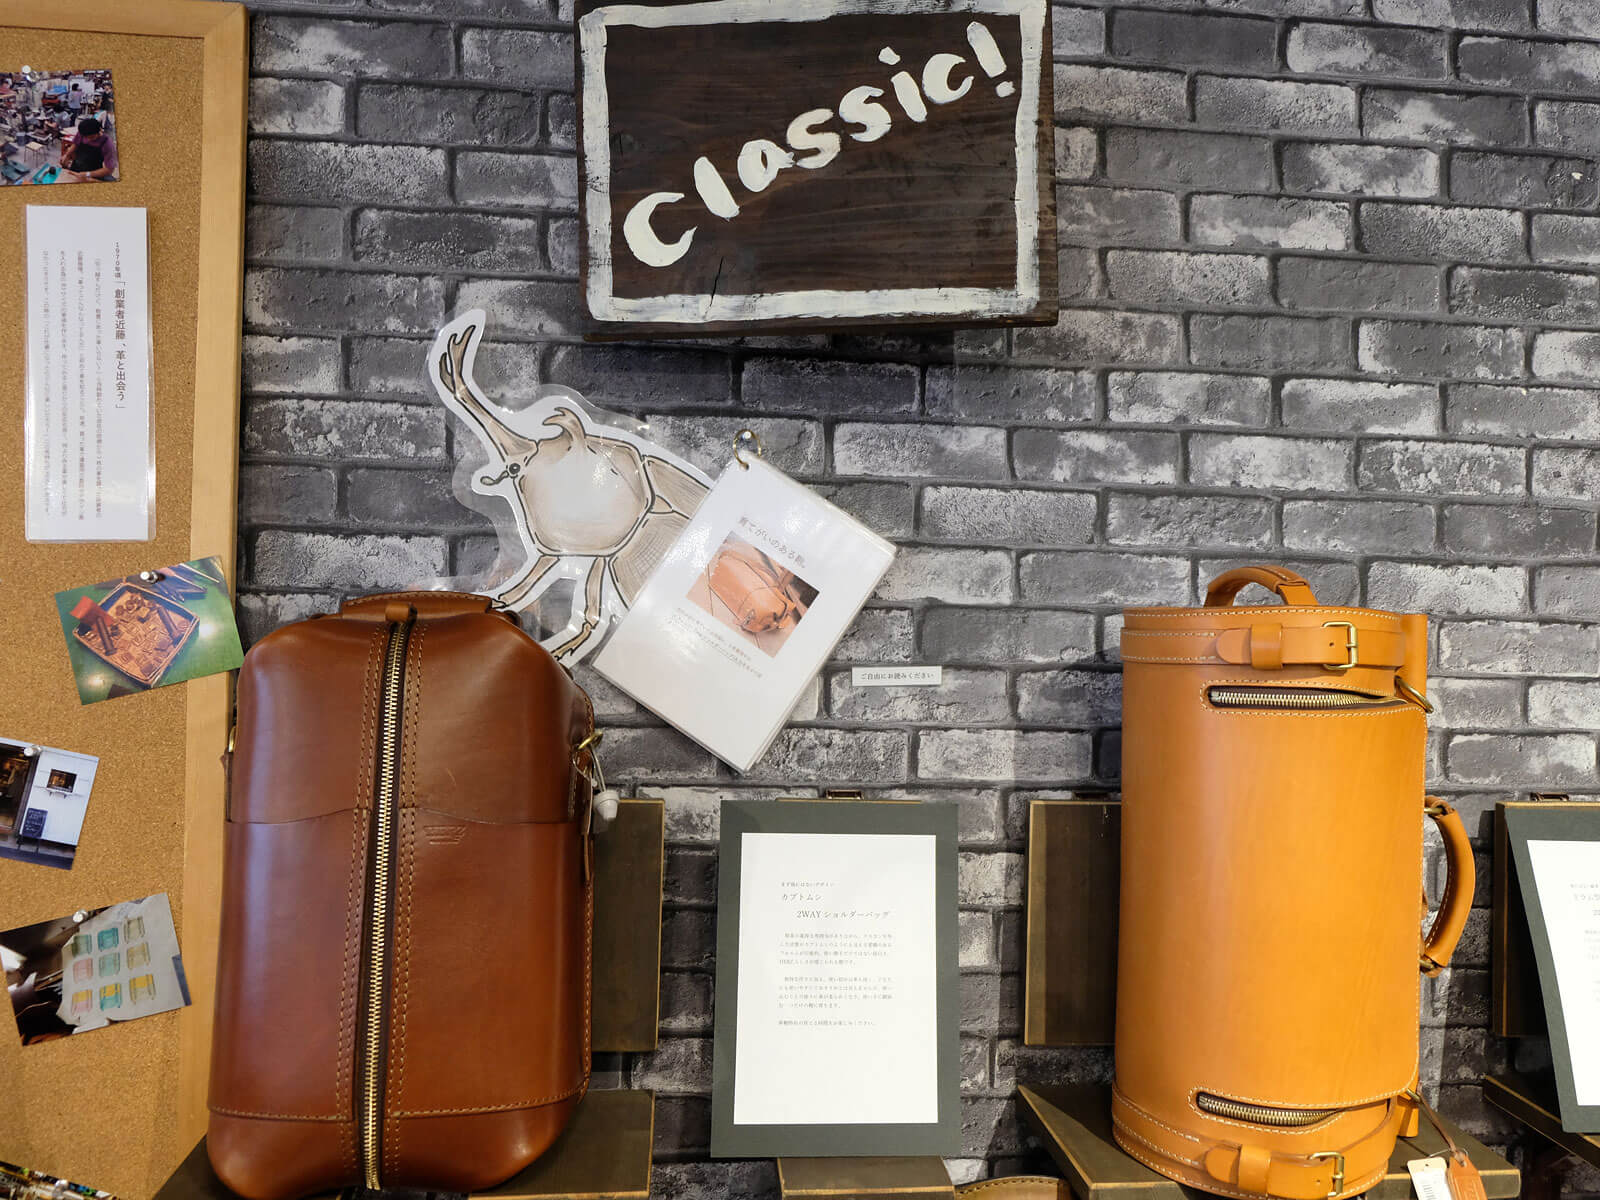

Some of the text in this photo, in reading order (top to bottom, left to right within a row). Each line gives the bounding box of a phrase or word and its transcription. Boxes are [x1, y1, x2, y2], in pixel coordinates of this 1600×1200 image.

[861, 671, 935, 681] ご自由にお読みください
